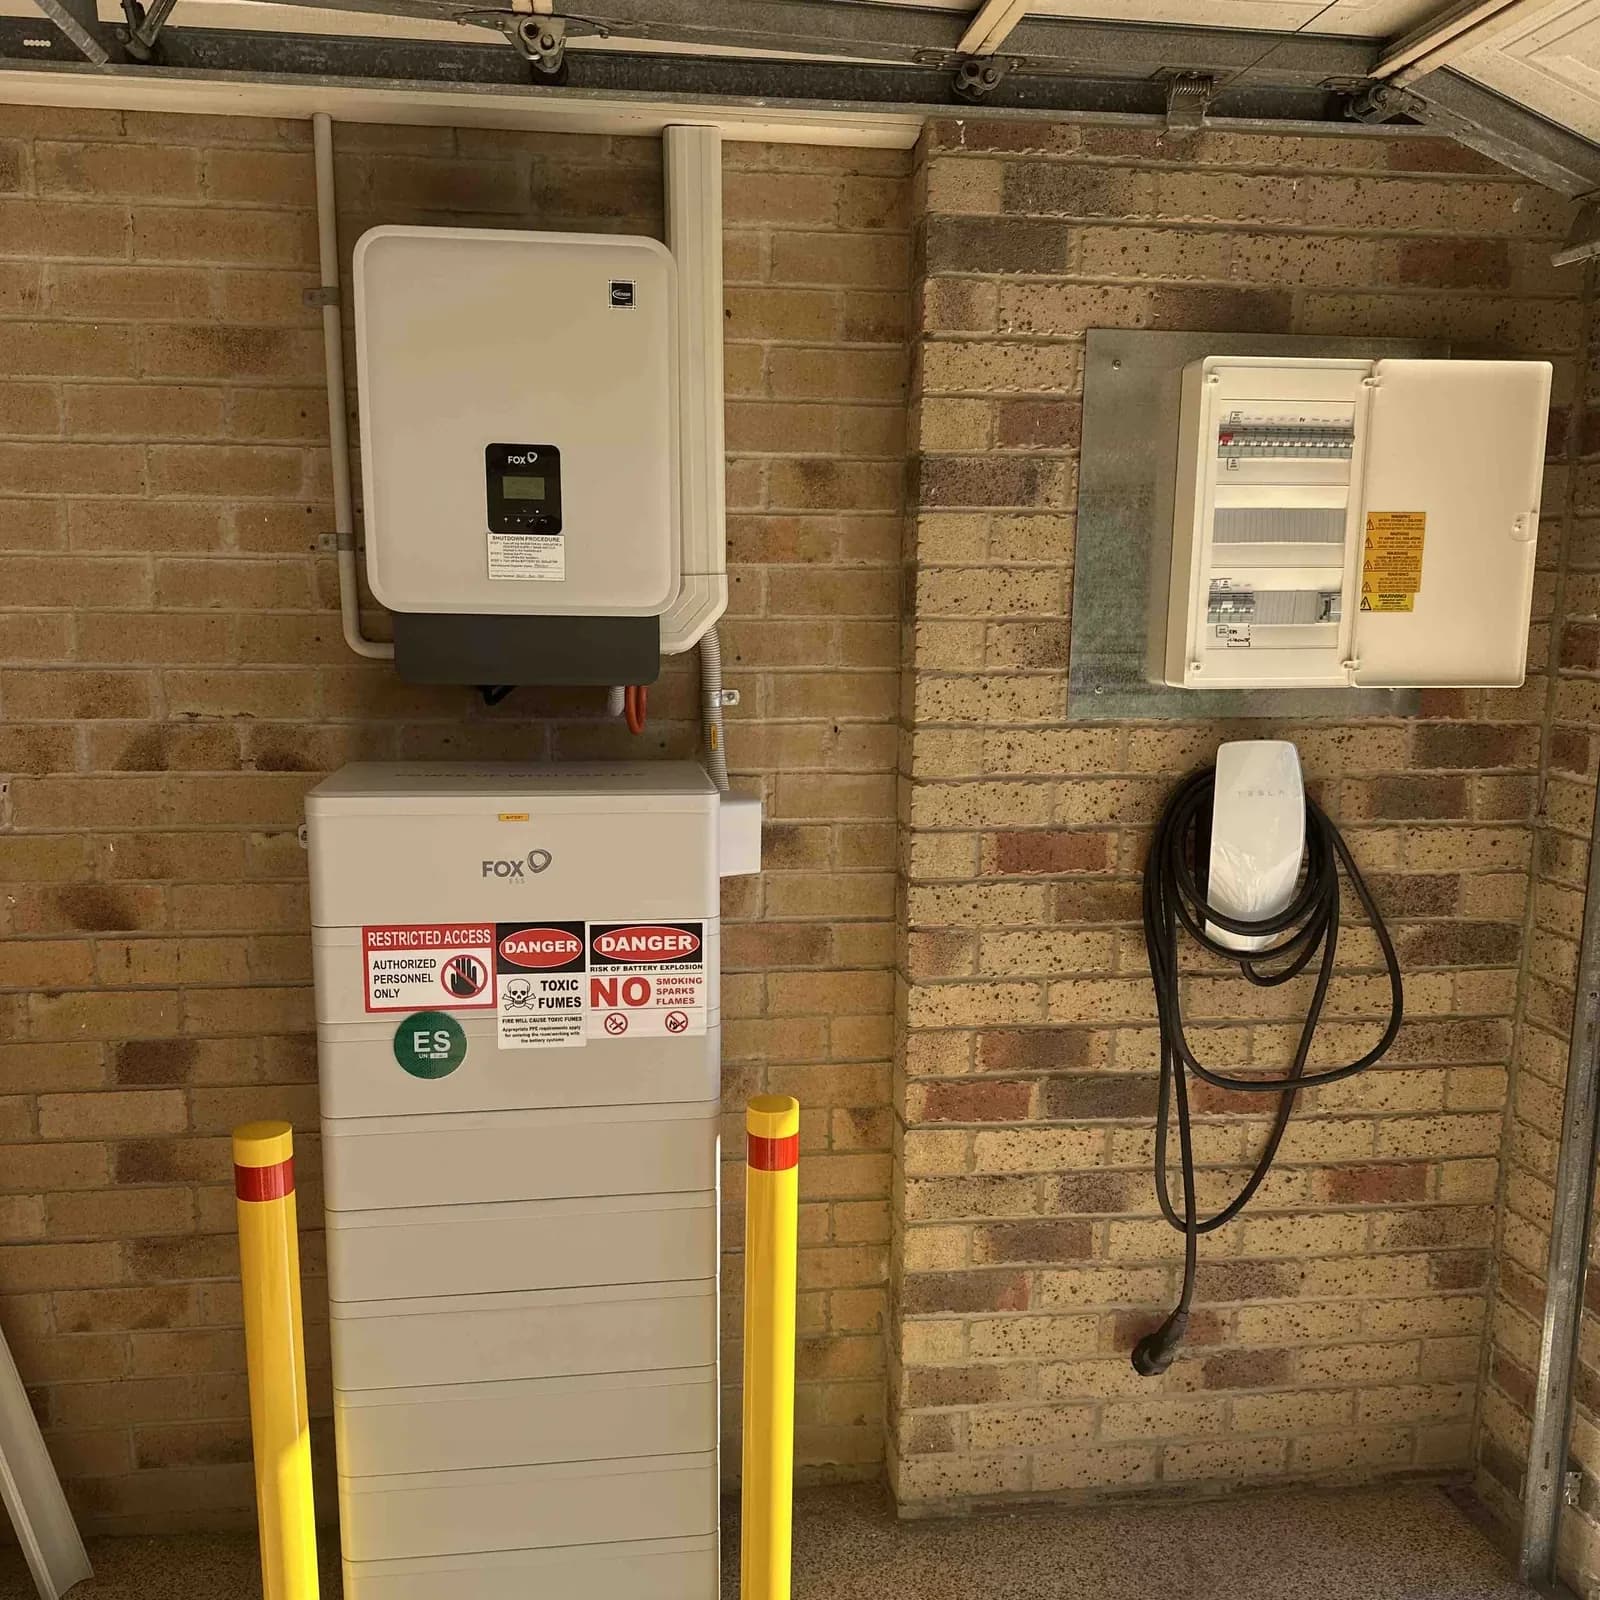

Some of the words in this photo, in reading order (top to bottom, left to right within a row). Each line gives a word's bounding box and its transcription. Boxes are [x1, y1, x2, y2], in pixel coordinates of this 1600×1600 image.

[507, 455, 526, 464] FOX
[482, 860, 524, 877] FOX
[368, 930, 441, 946] RESTRICTED
[444, 929, 491, 944] ACCESS
[601, 935, 692, 952] DANGER
[504, 940, 578, 954] DANGER
[373, 958, 436, 970] AUTHORIZED
[374, 974, 434, 984] PERSONNEL
[656, 977, 703, 986] SMOKING
[540, 980, 579, 992] TOXIC
[590, 976, 651, 1008] NO
[656, 987, 695, 996] SPARKS
[374, 988, 400, 999] ONLY
[538, 996, 582, 1009] FUMES
[656, 997, 696, 1006] FLAMES
[414, 1030, 452, 1052] ES
